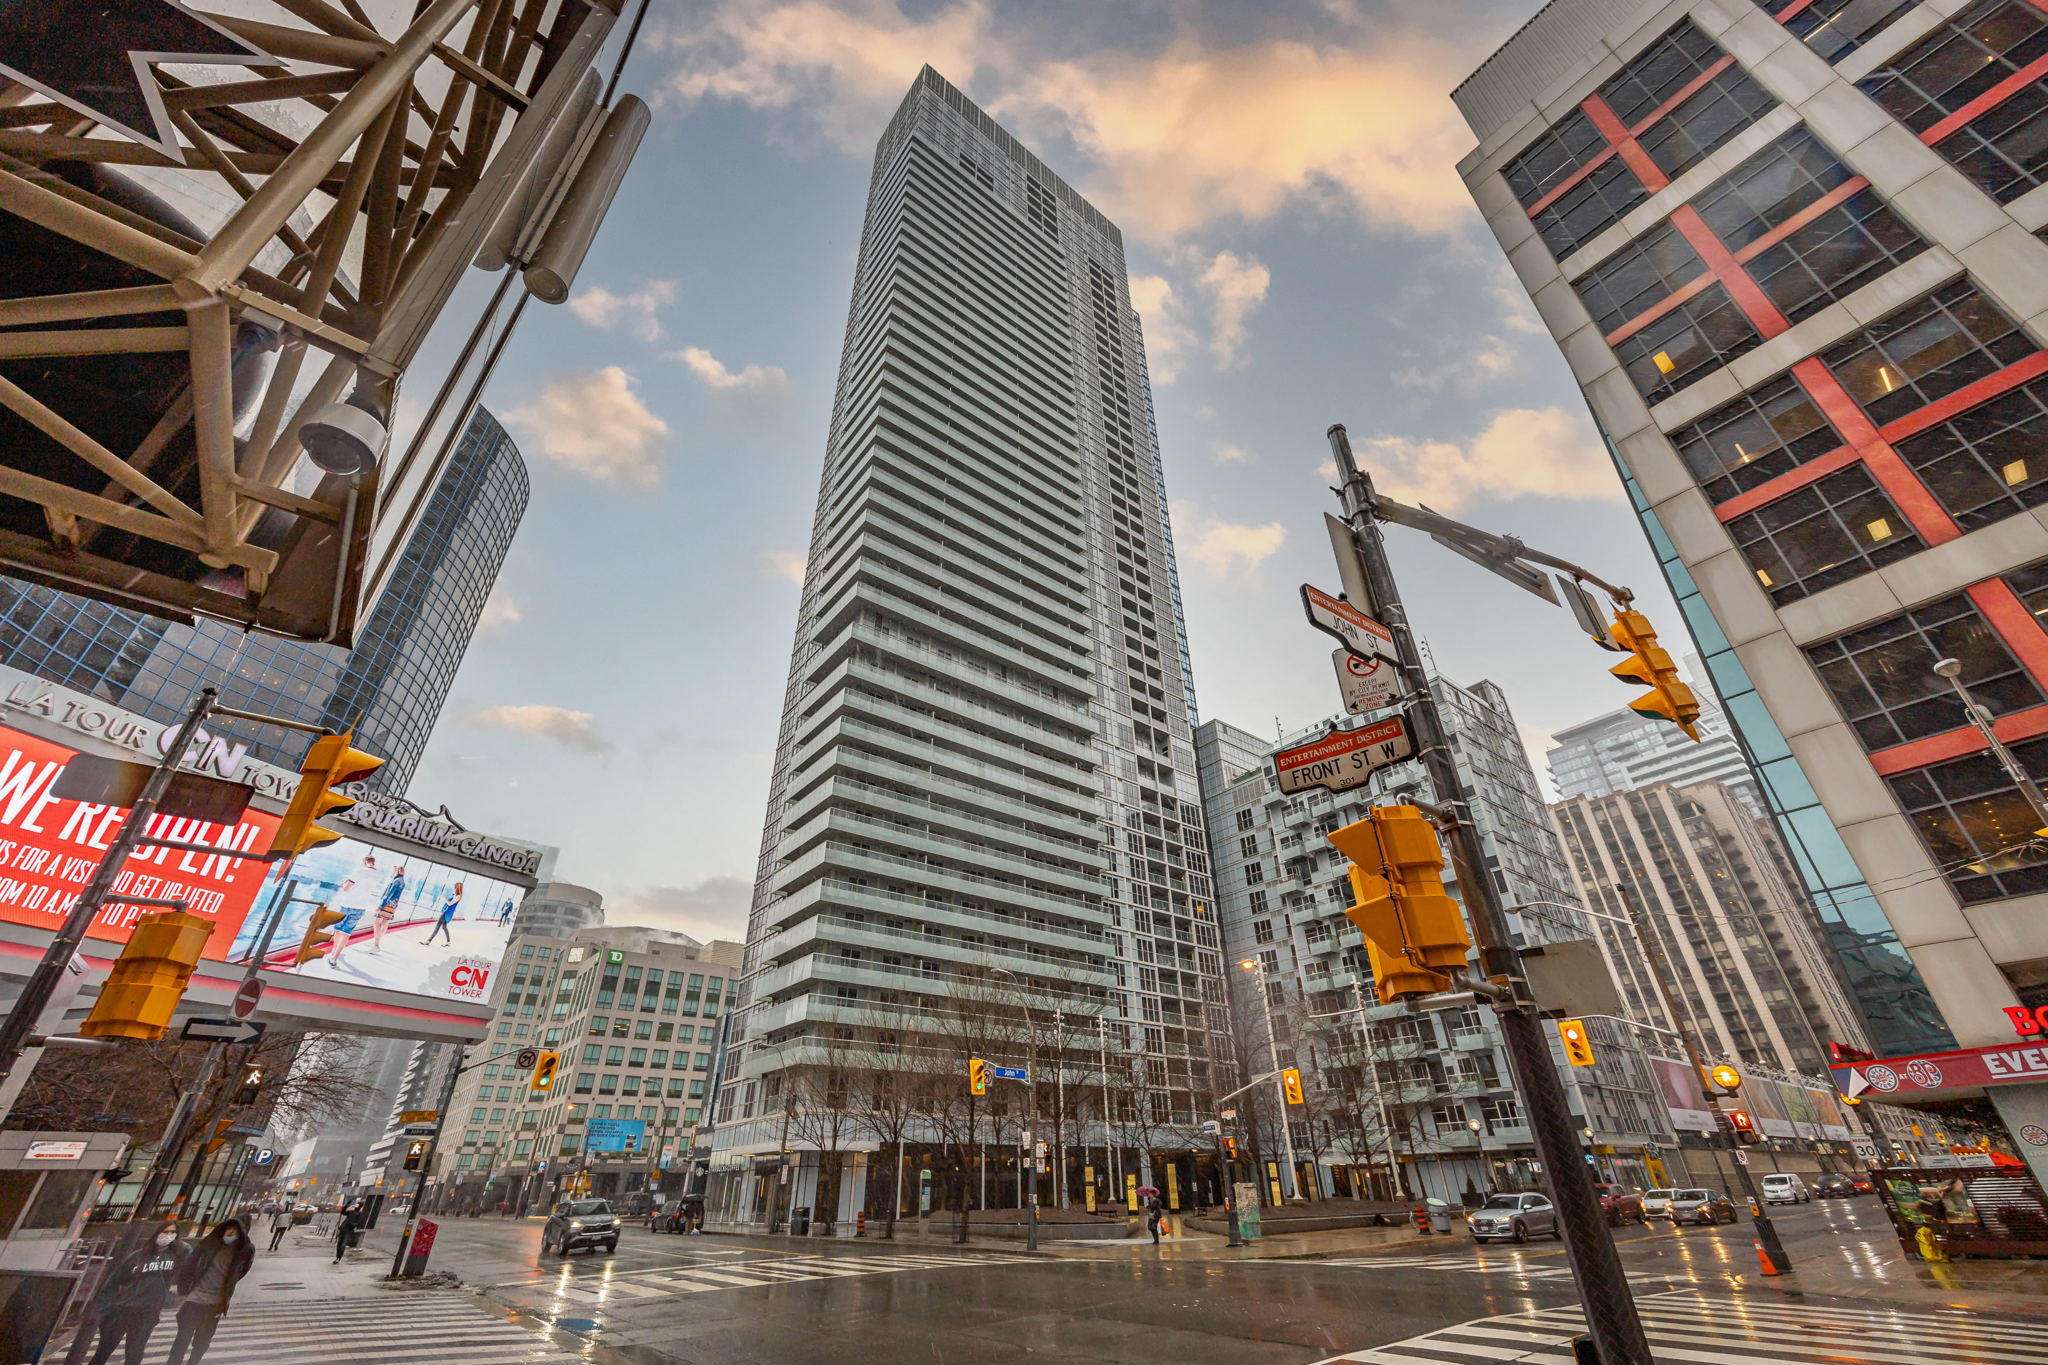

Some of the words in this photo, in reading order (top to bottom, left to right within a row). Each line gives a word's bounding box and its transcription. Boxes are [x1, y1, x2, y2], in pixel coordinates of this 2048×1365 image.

[1333, 615, 1359, 641] JOHN
[1358, 694, 1387, 705] REMOVAL
[1365, 701, 1382, 709] ZONE
[5, 681, 54, 716] LA
[61, 700, 150, 748] TOUR
[157, 723, 248, 778] CN
[241, 765, 298, 799] TOW
[1280, 737, 1355, 767] ENTERTAINMENT
[1356, 724, 1399, 744] DISTRICT
[1291, 758, 1342, 786] FRONT
[1351, 749, 1375, 769] ST.
[1380, 741, 1400, 760] W.
[1341, 776, 1356, 786] 301
[342, 803, 455, 849] AQUARIUM
[459, 836, 540, 875] CANADA
[10, 845, 51, 873] FOR
[43, 853, 63, 877] A
[111, 869, 135, 894] ND
[130, 874, 165, 899] GET
[21, 884, 49, 910] 10
[42, 889, 81, 916] A.M
[457, 957, 469, 966] LA
[470, 959, 492, 970] TOUR
[610, 951, 623, 962] TD
[450, 965, 489, 990] CN
[447, 985, 482, 999] TOWER
[1898, 1073, 1908, 1081] AT
[1856, 1145, 1876, 1157] 30
